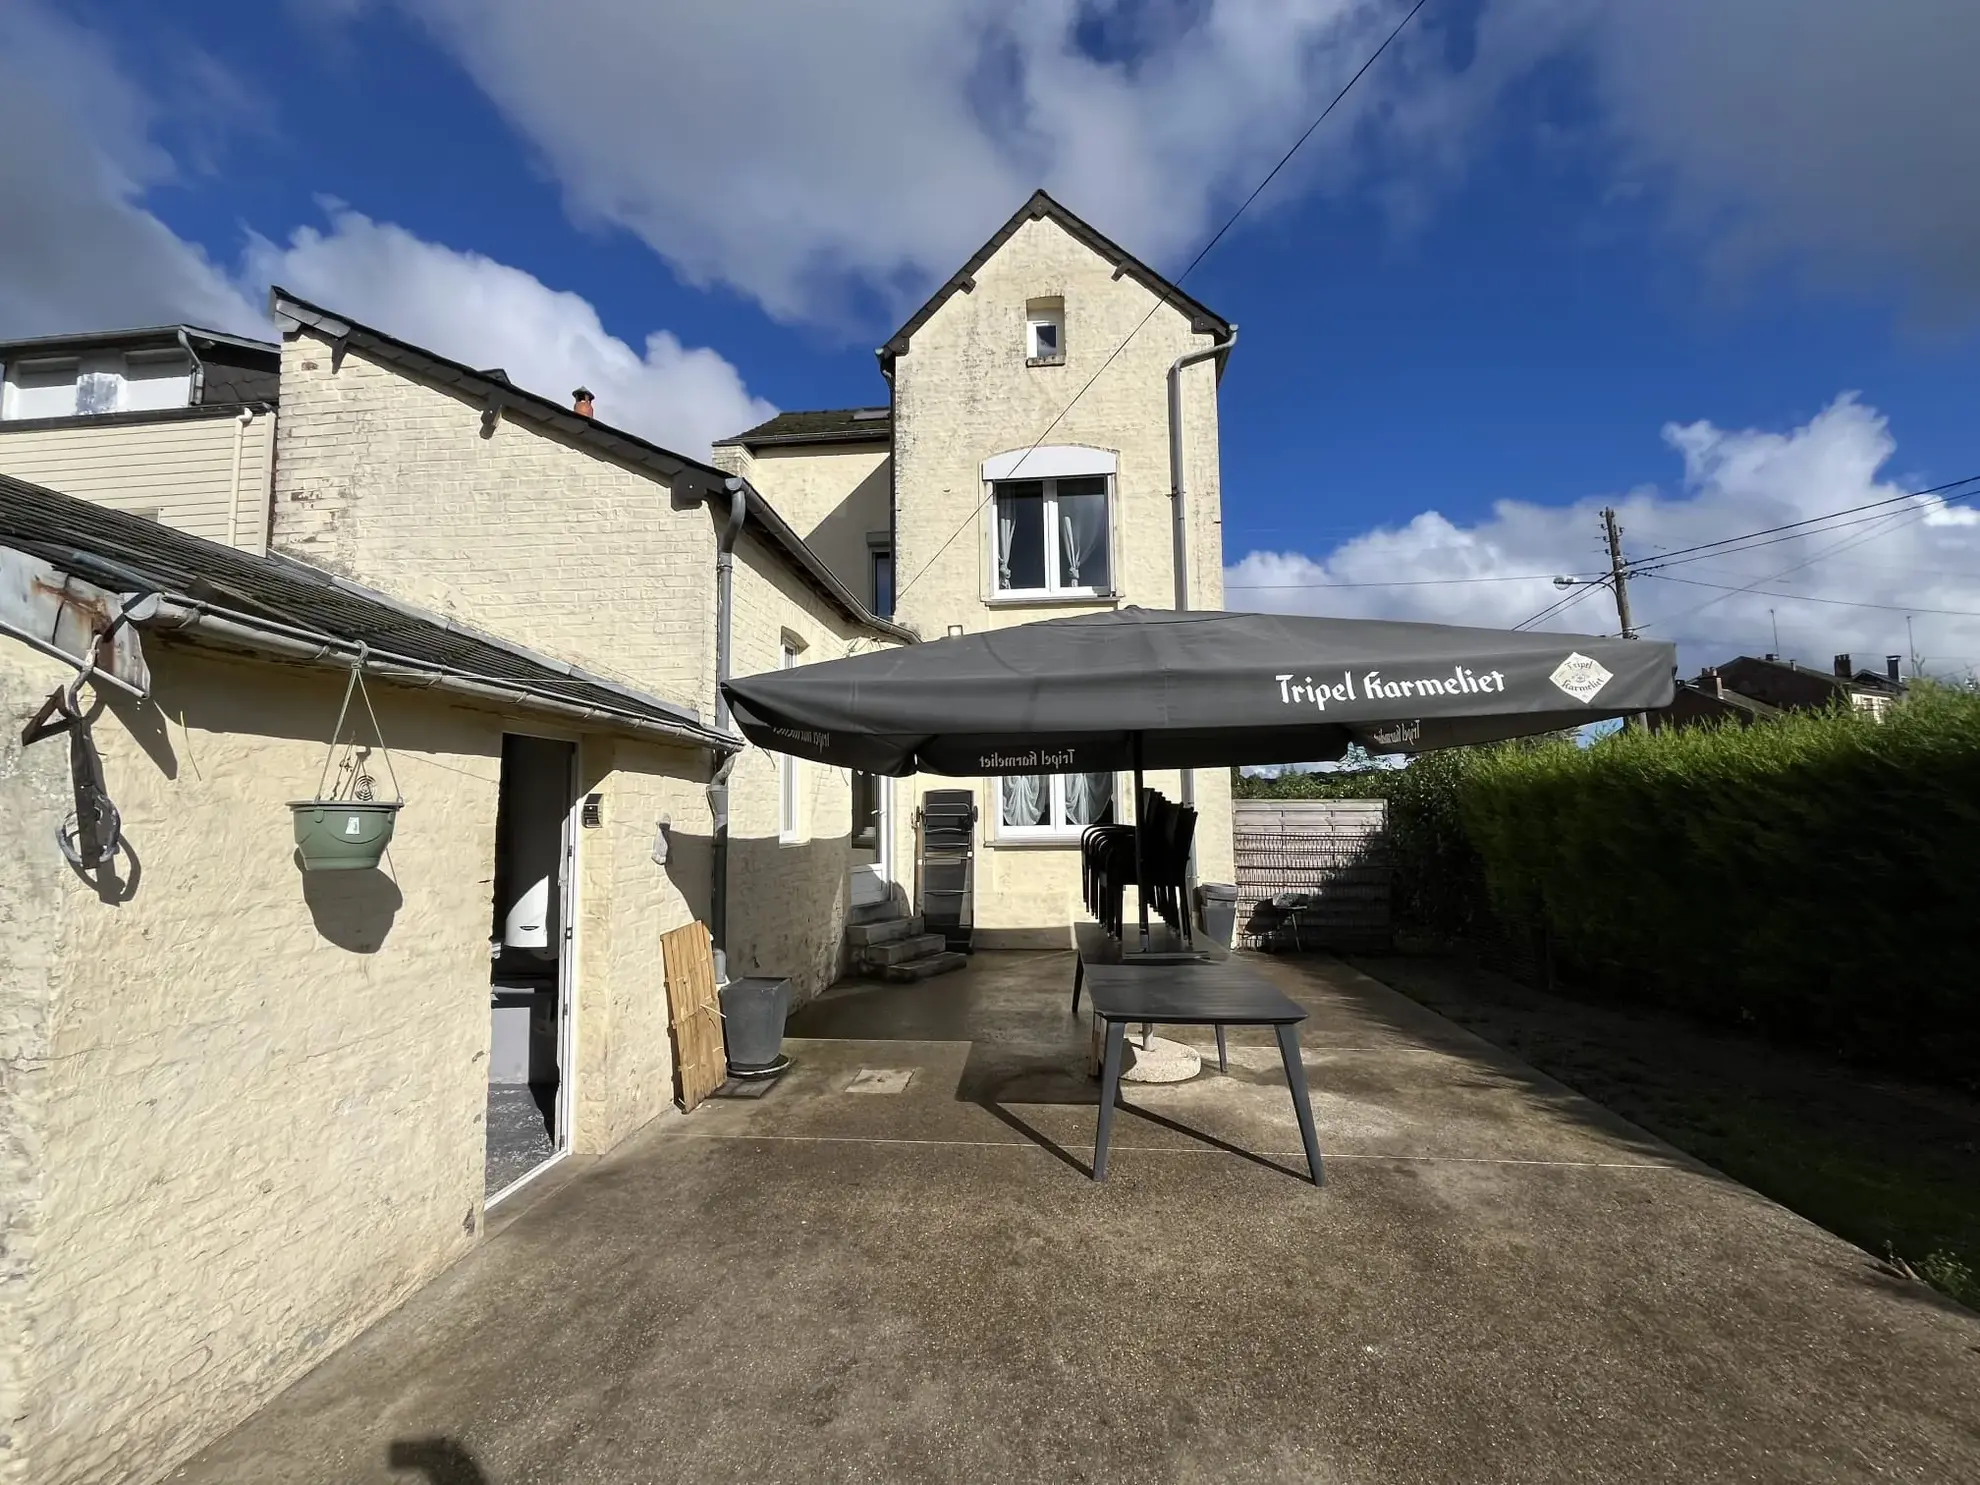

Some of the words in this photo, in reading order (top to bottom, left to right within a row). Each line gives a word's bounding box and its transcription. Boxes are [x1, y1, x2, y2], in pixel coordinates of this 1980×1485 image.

[1565, 660, 1594, 670] Tripel
[1276, 670, 1356, 711] Tripel
[1363, 665, 1505, 701] Karmeliet
[1561, 677, 1605, 692] Karmeliet
